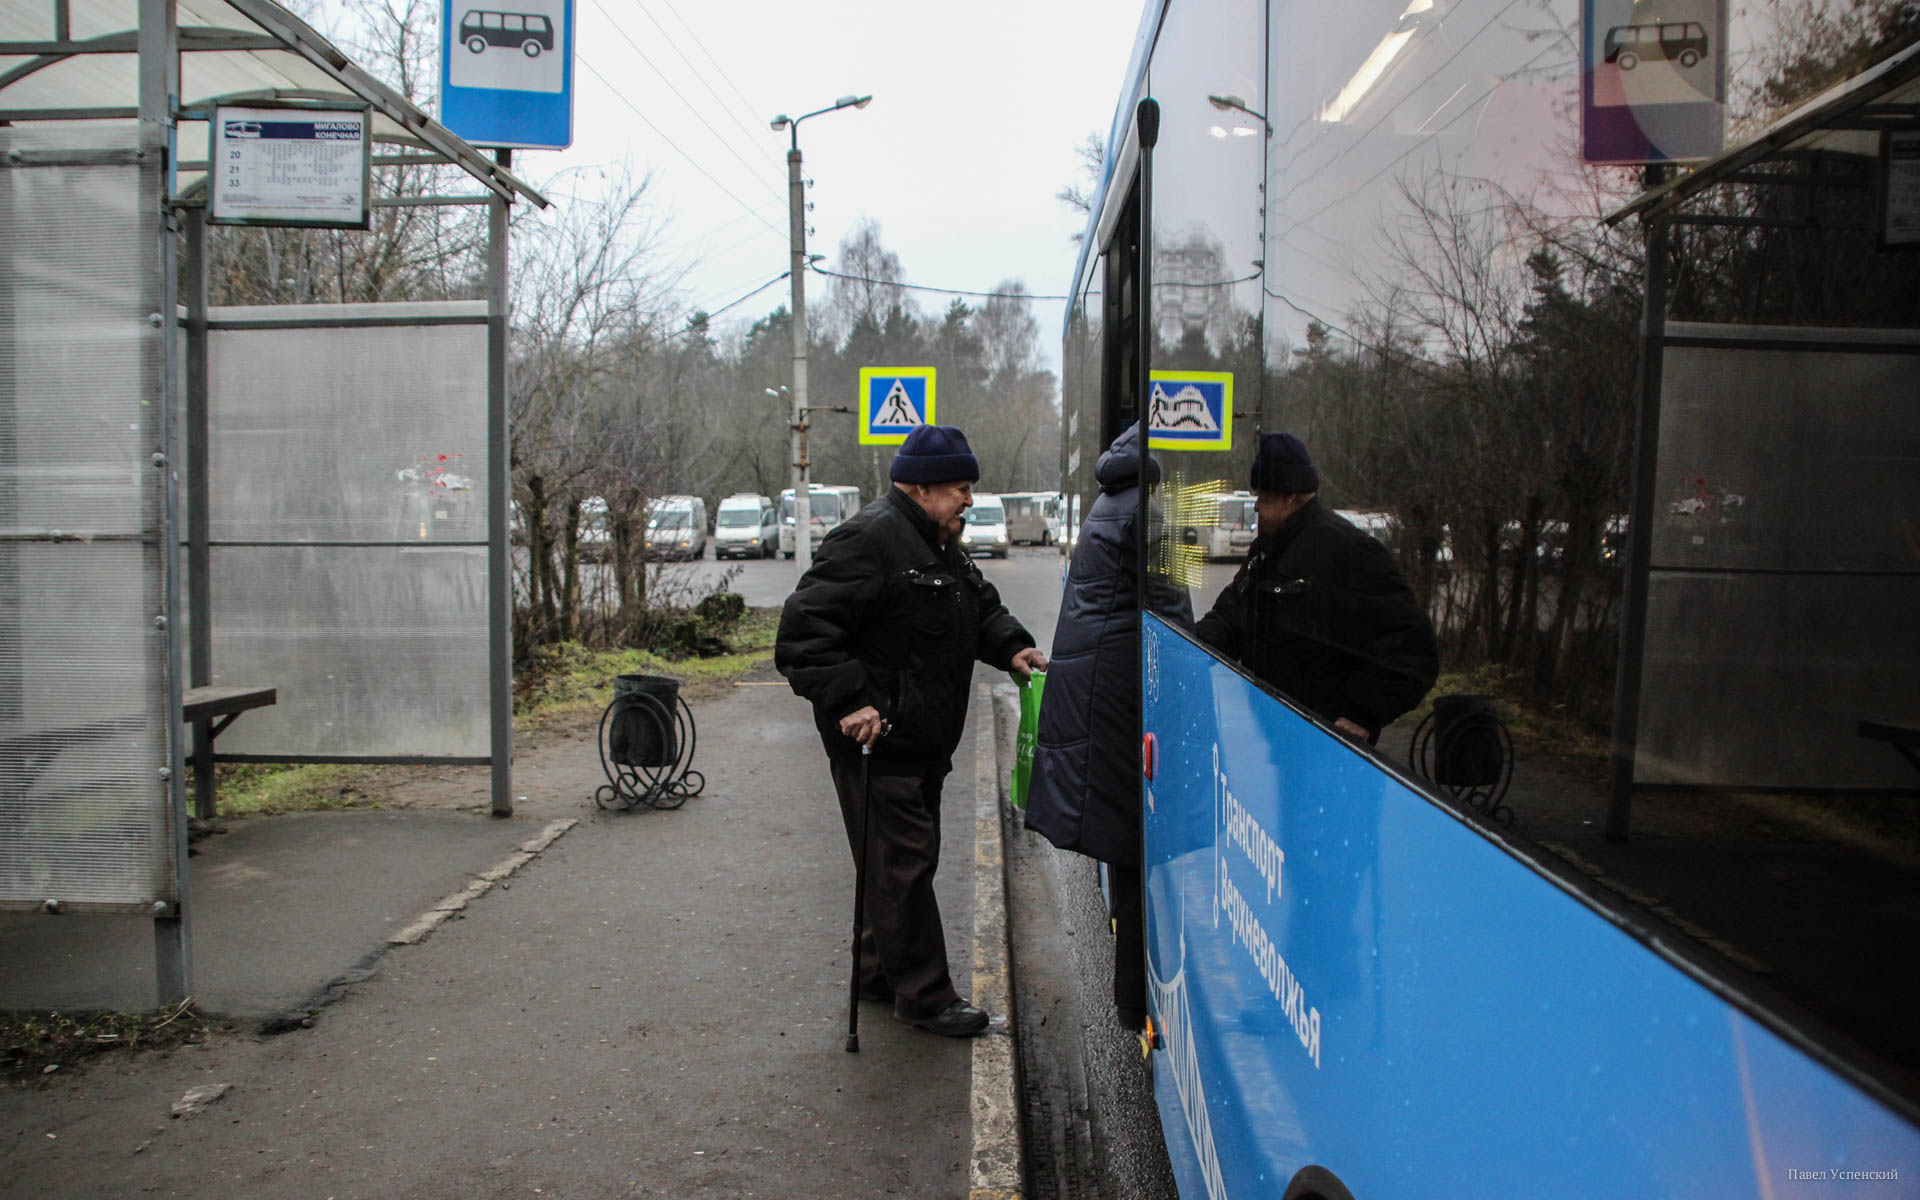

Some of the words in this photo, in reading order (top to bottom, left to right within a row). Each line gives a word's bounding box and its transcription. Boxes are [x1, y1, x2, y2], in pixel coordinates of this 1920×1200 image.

[314, 122, 360, 130] МИГАЛОВО
[314, 131, 360, 139] КОНЕЧНАЯ
[230, 150, 241, 159] 20
[229, 165, 240, 174] 21
[228, 179, 240, 188] 33
[1220, 776, 1285, 904] Транспорт
[1221, 855, 1322, 1070] Верхневолжья
